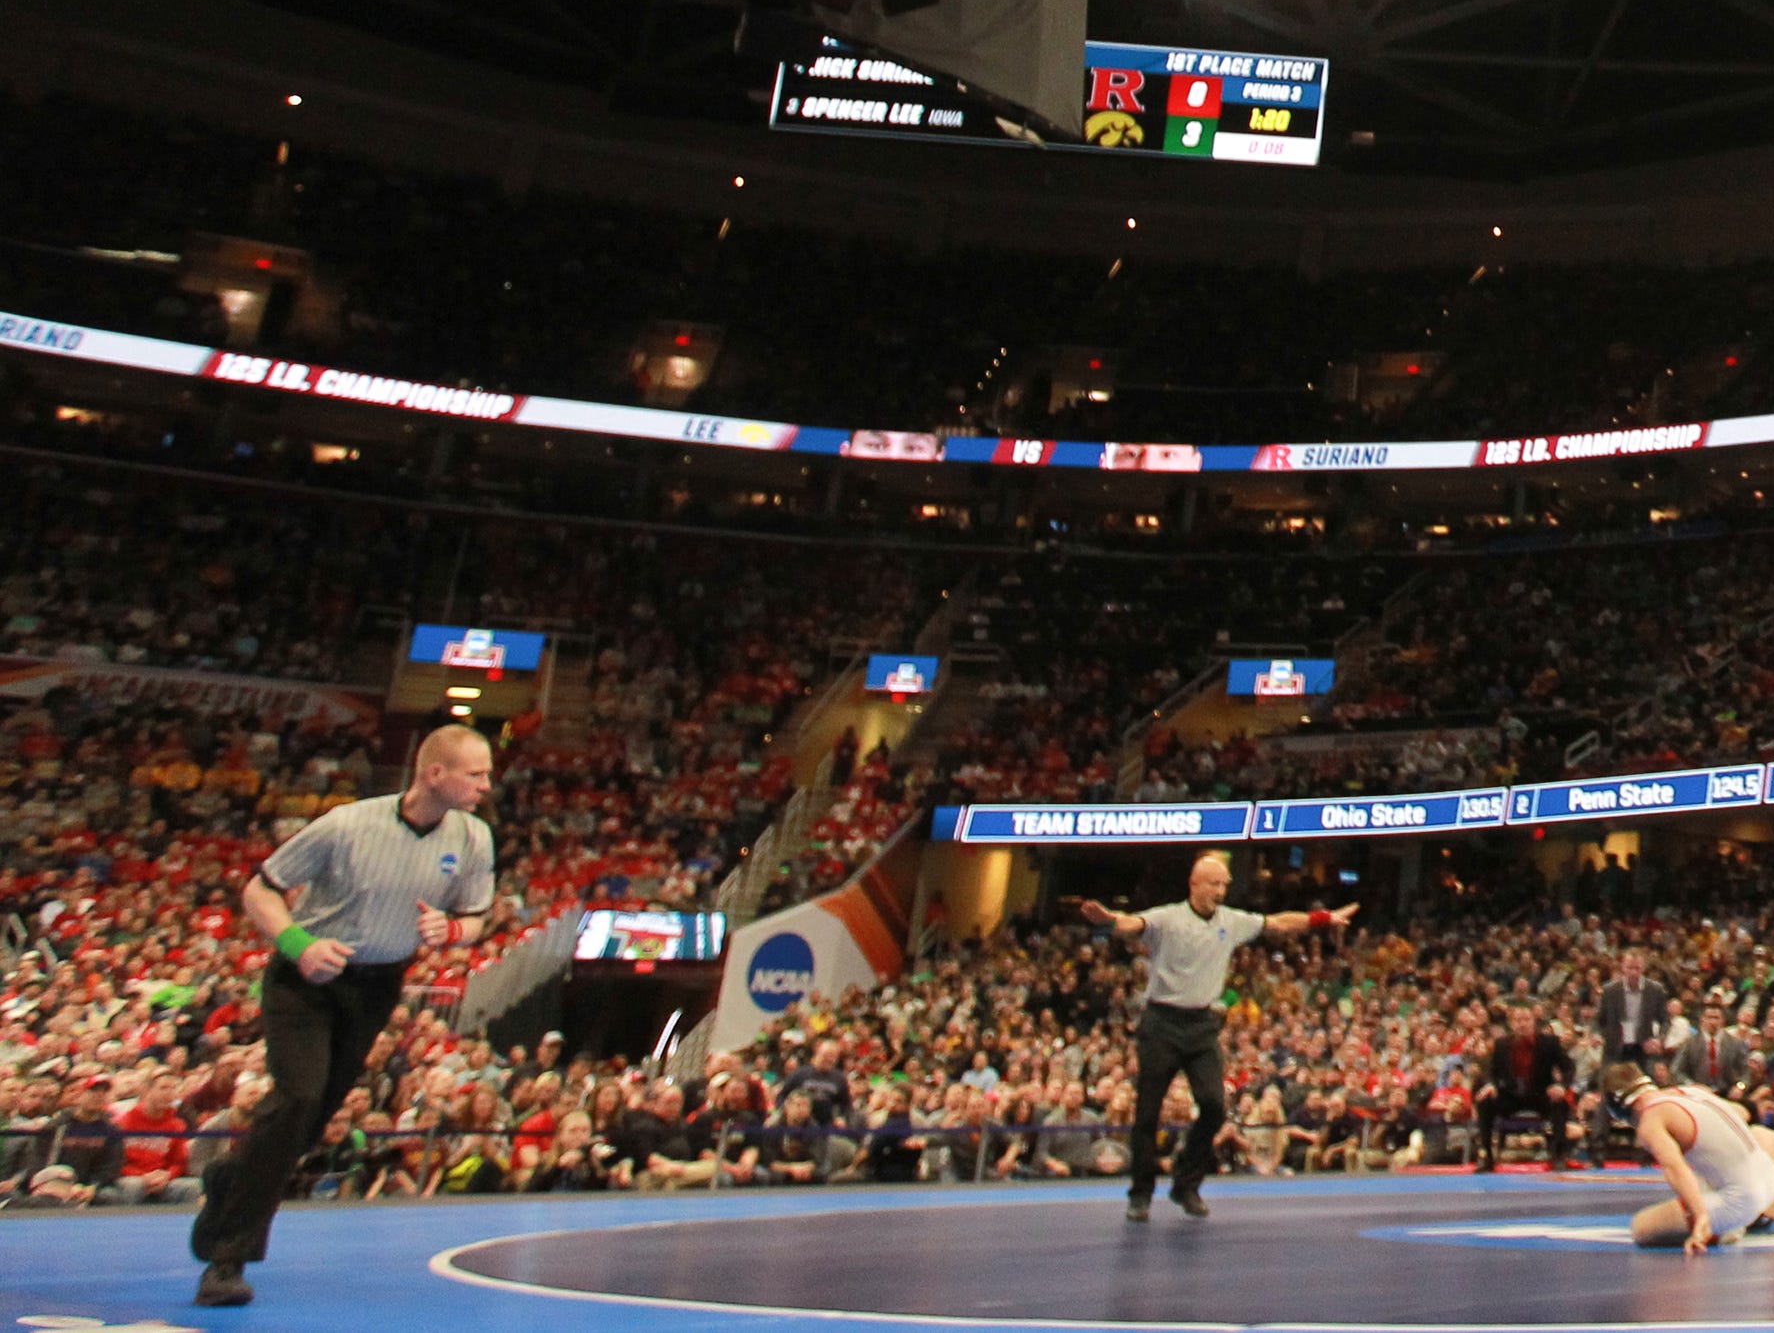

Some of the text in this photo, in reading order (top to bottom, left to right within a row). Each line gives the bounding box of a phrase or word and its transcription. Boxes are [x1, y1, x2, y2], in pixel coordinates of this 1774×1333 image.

[1166, 52, 1316, 82] 1ST PLACE MATCH
[1086, 66, 1146, 114] R
[1187, 80, 1209, 108] 0
[1242, 81, 1290, 101] PERIOD
[801, 96, 889, 123] SPENCER
[888, 102, 926, 126] LEE
[928, 108, 965, 129] IOWA
[1181, 119, 1204, 148] 3
[214, 352, 272, 384] 125
[313, 368, 515, 419] CHAMPIONSHIP
[681, 415, 723, 442] LEE
[1011, 439, 1043, 466] VS
[1267, 443, 1390, 471] R SURIANO
[1484, 439, 1522, 465] 125
[1554, 423, 1703, 460] CHAMPIONSHIP
[1516, 772, 1761, 815] 2 Penn State 124.5
[1012, 810, 1203, 836] TEAM STANDINGS
[1263, 810, 1275, 831] 1
[1320, 804, 1366, 830] Ohio
[1369, 802, 1427, 828] State
[750, 967, 813, 995] NCAA
